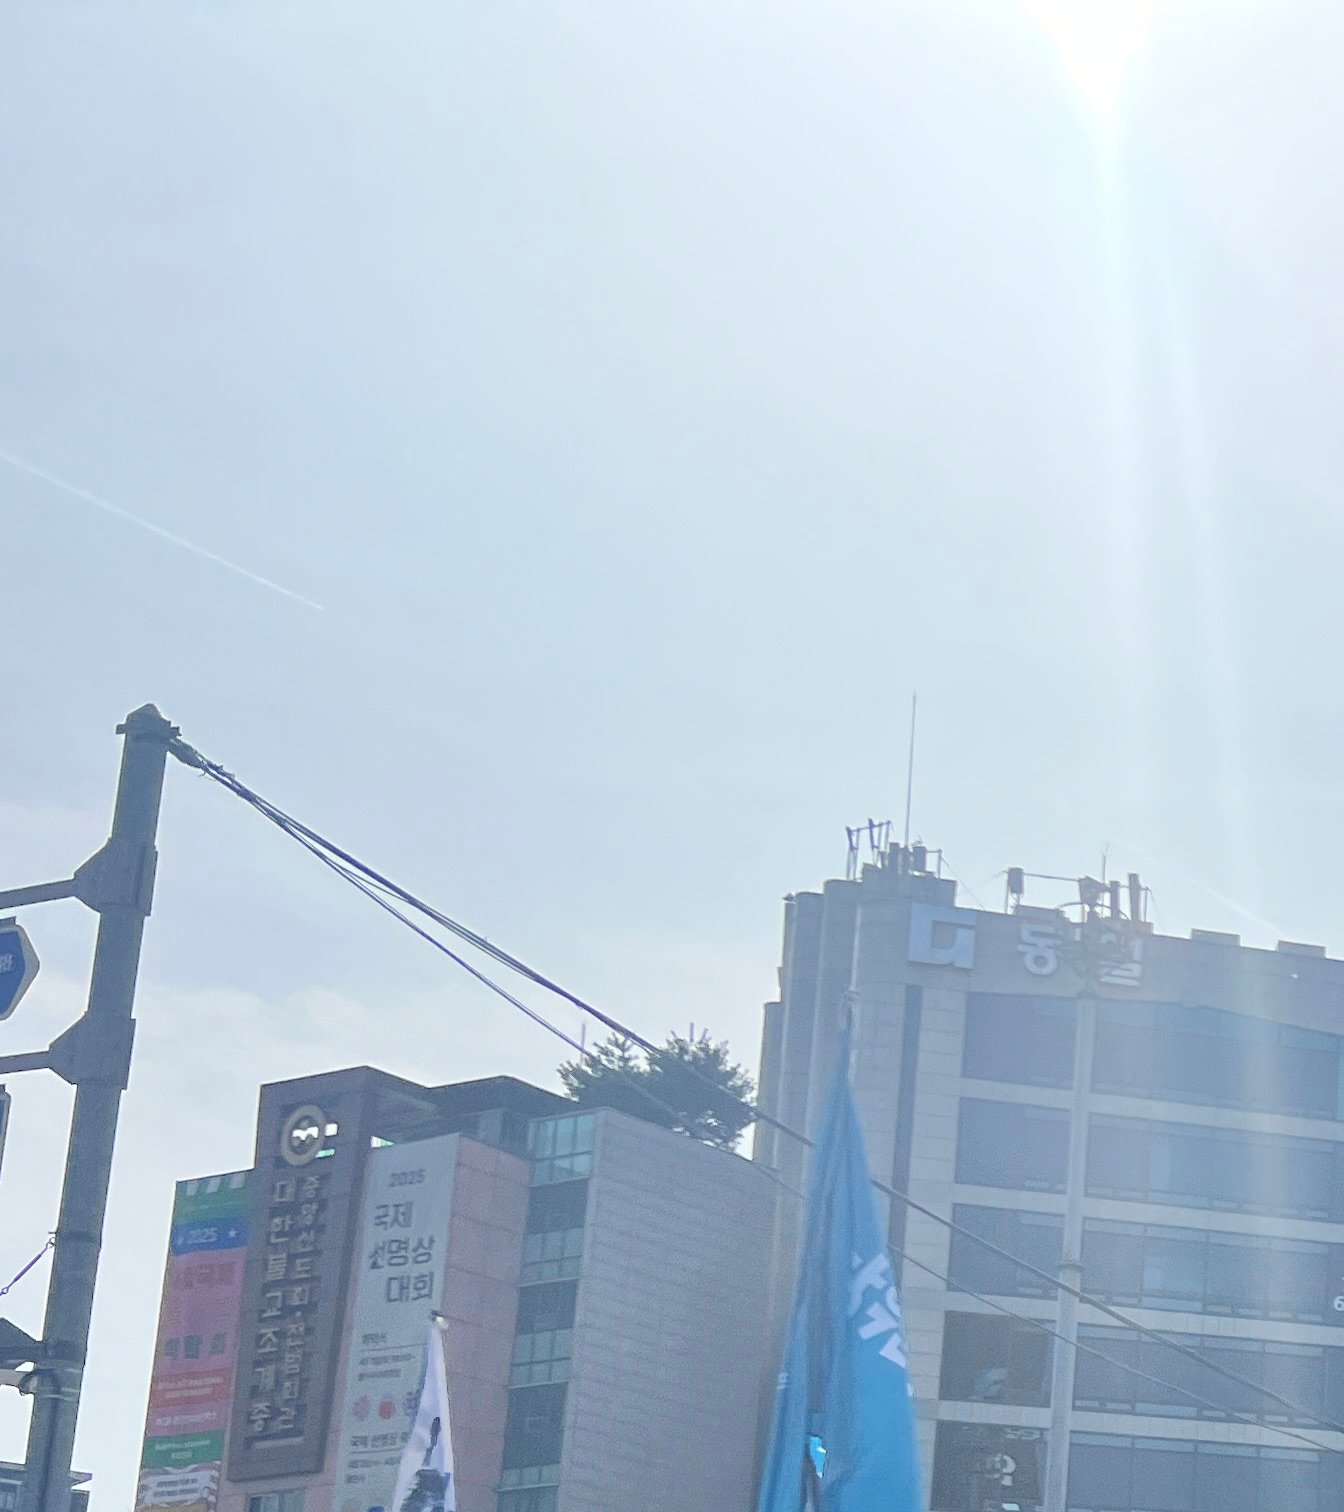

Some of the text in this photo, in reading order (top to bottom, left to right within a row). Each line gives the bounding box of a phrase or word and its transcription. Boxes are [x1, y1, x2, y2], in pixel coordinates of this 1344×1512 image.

[374, 1200, 414, 1232] 국제
[368, 1235, 436, 1271] 선명상
[386, 1272, 435, 1304] 대회
[250, 1179, 297, 1432] 대한불교조계종
